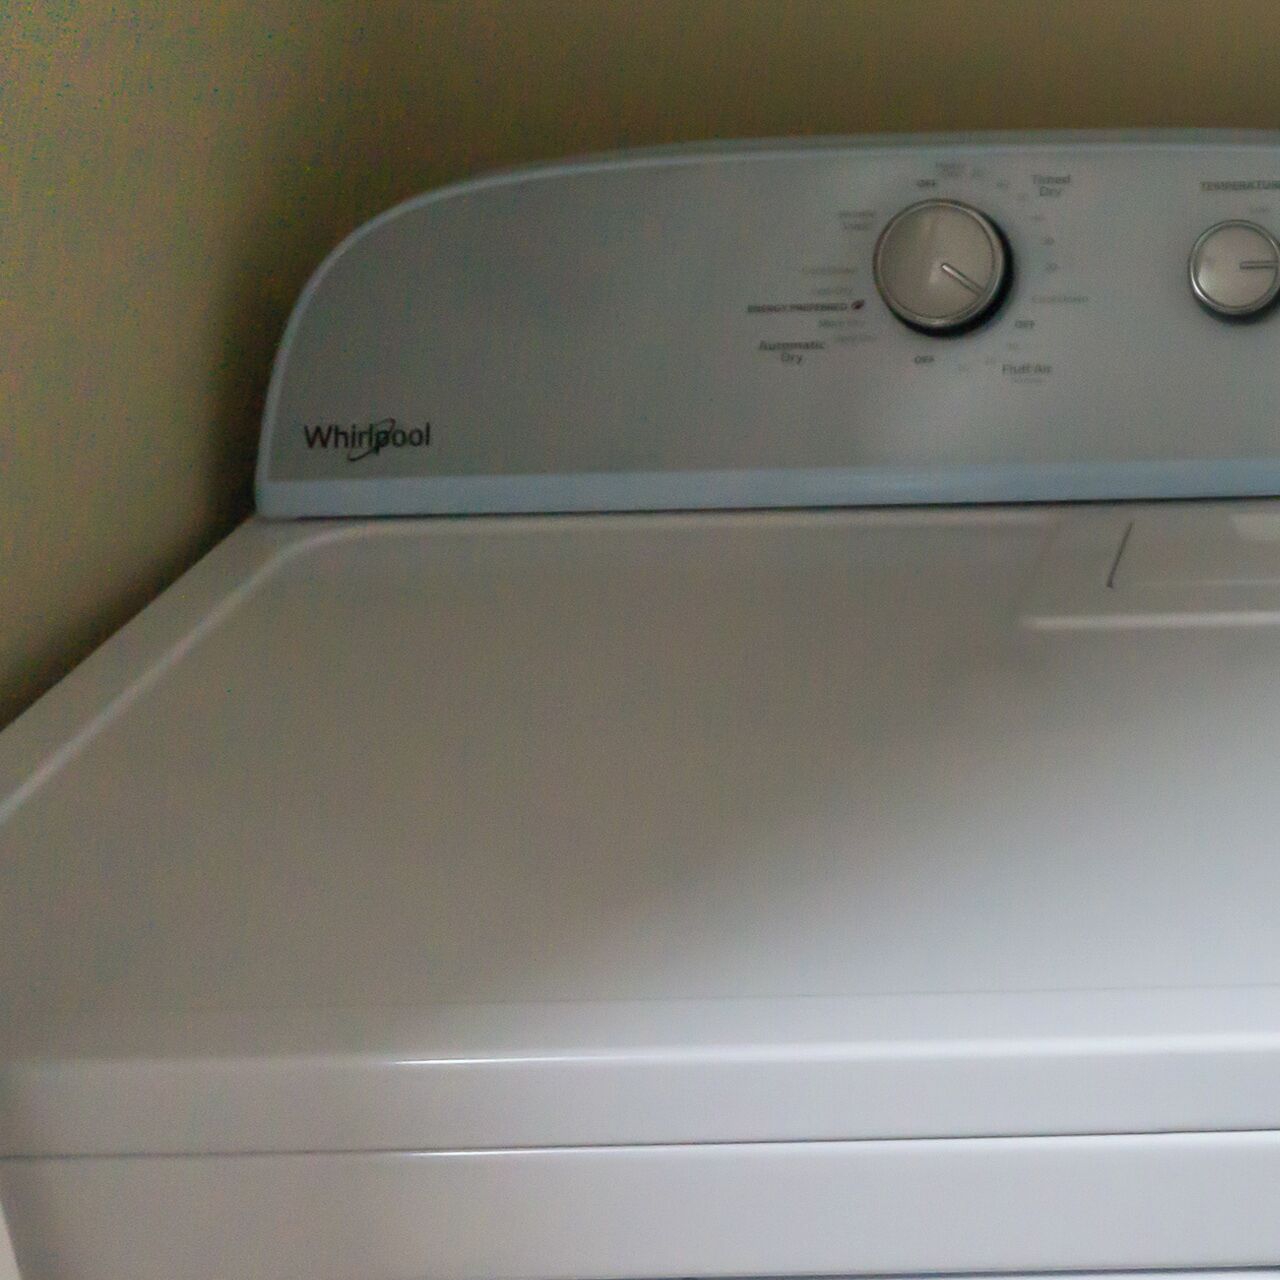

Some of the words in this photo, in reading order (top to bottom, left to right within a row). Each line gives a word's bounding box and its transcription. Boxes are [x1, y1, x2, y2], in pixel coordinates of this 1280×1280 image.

[759, 341, 824, 351] Automatic
[781, 352, 803, 365] Dry
[303, 420, 431, 461] Whirlpool
